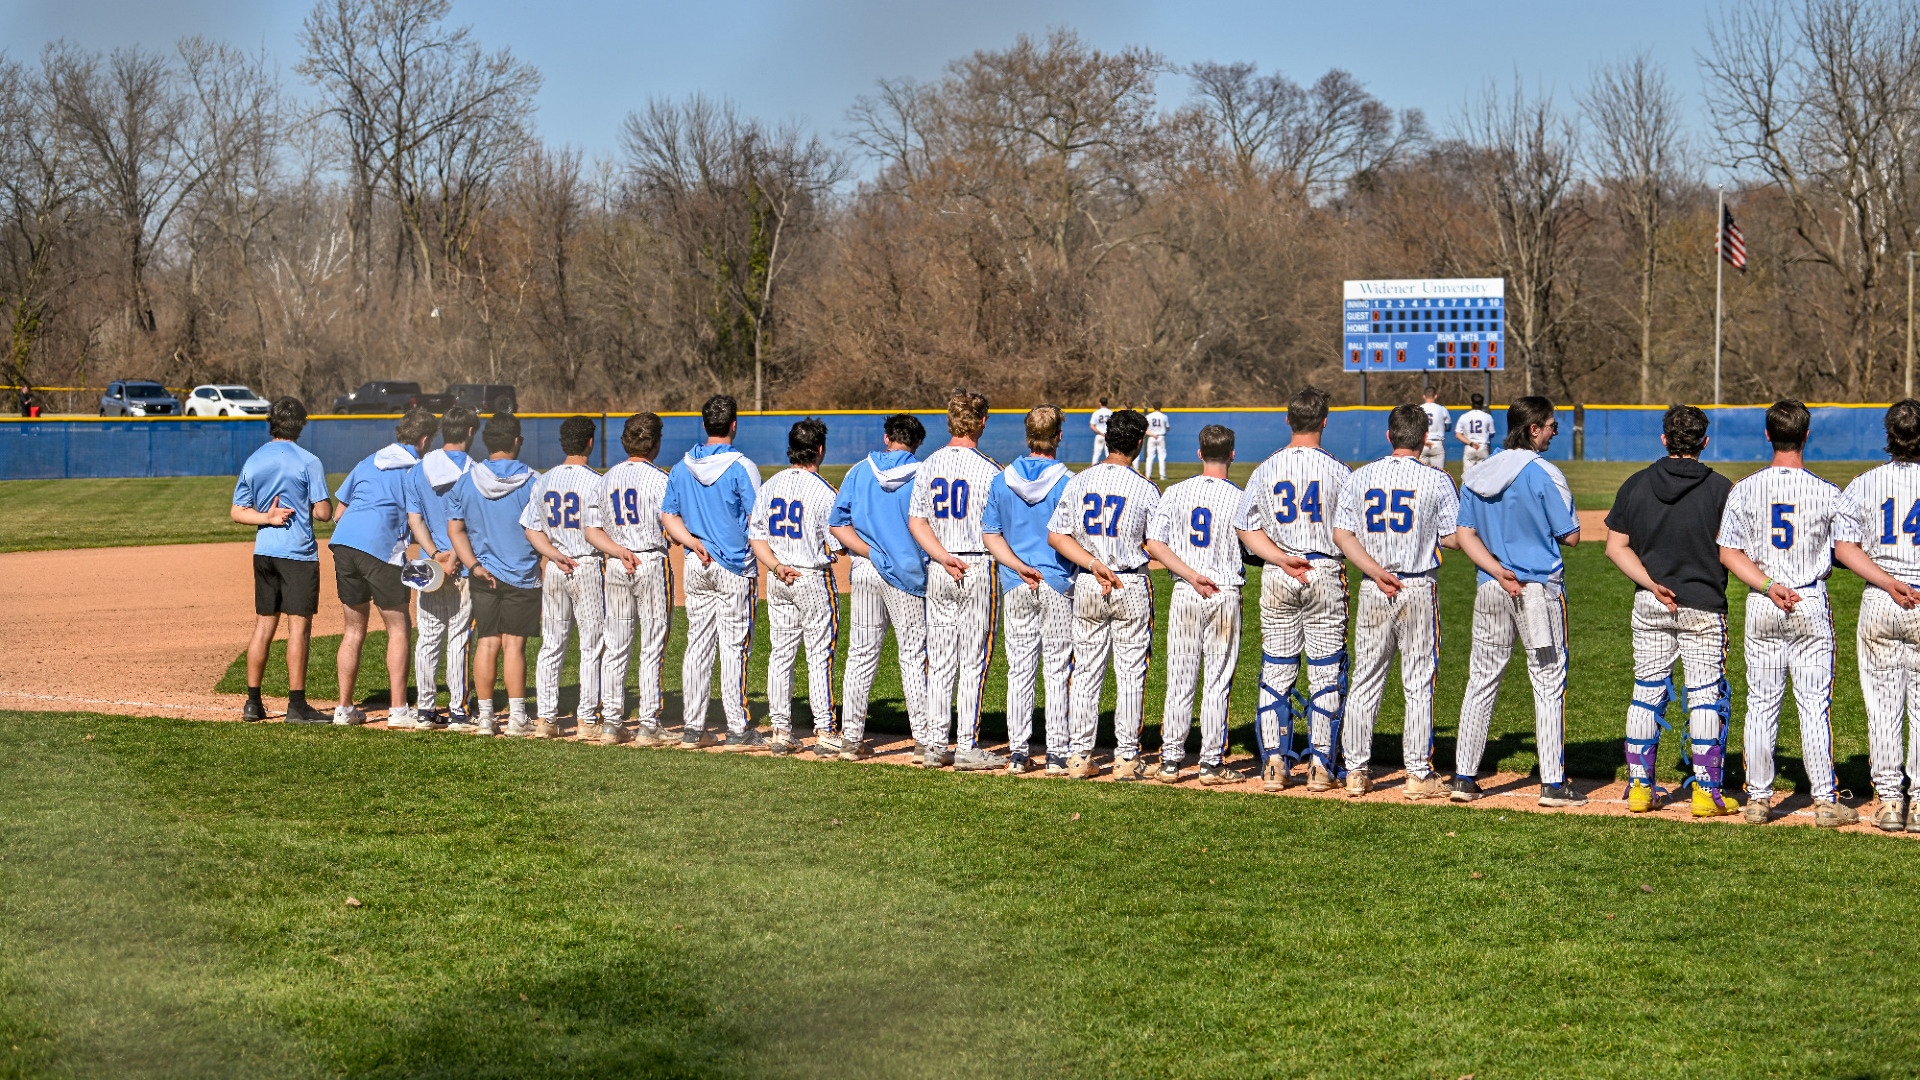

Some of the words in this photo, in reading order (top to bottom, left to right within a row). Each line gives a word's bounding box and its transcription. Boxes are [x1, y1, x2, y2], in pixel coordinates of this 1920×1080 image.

[1360, 282, 1416, 294] Widener
[1422, 282, 1488, 296] University
[1346, 300, 1370, 308] INNING
[1346, 312, 1369, 320] GUEST
[1373, 311, 1379, 321] 0
[1346, 324, 1369, 332] HOME
[1437, 333, 1455, 342] RUNS
[1461, 333, 1479, 341] HITS
[1347, 342, 1364, 350] BALL
[1447, 342, 1455, 353] 0
[1471, 342, 1479, 353] 0
[1488, 341, 1497, 353] 0
[1428, 358, 1435, 366] H
[1447, 355, 1455, 368] 0
[1471, 355, 1479, 368] 0
[1488, 355, 1497, 368] 0
[1152, 418, 1161, 427] 21
[1470, 420, 1482, 433] 12
[544, 491, 580, 529] 32
[611, 488, 639, 526] 19
[931, 477, 969, 519] 20
[1273, 480, 1322, 524] 34
[1365, 488, 1415, 533] 25
[768, 497, 803, 539] 29
[1082, 493, 1126, 537] 27
[1190, 506, 1212, 548] 9
[1771, 503, 1795, 550] 5
[1880, 497, 1920, 546] 14
